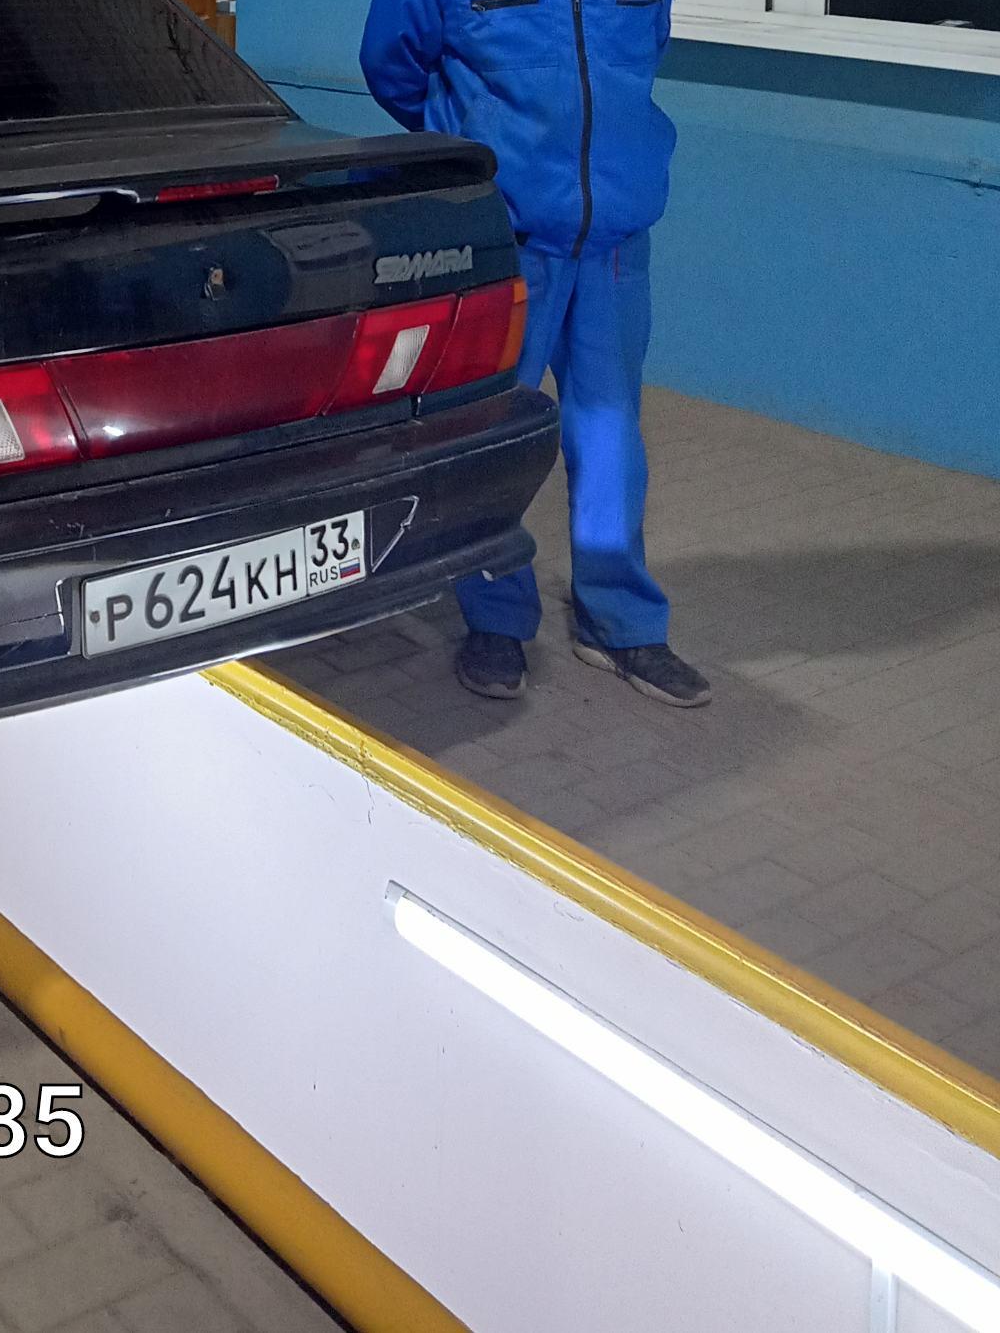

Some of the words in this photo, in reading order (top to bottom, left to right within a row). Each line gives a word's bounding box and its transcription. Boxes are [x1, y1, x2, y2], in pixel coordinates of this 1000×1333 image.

[373, 244, 474, 285] SAMARA
[309, 518, 350, 567] 33
[309, 566, 339, 588] RUS
